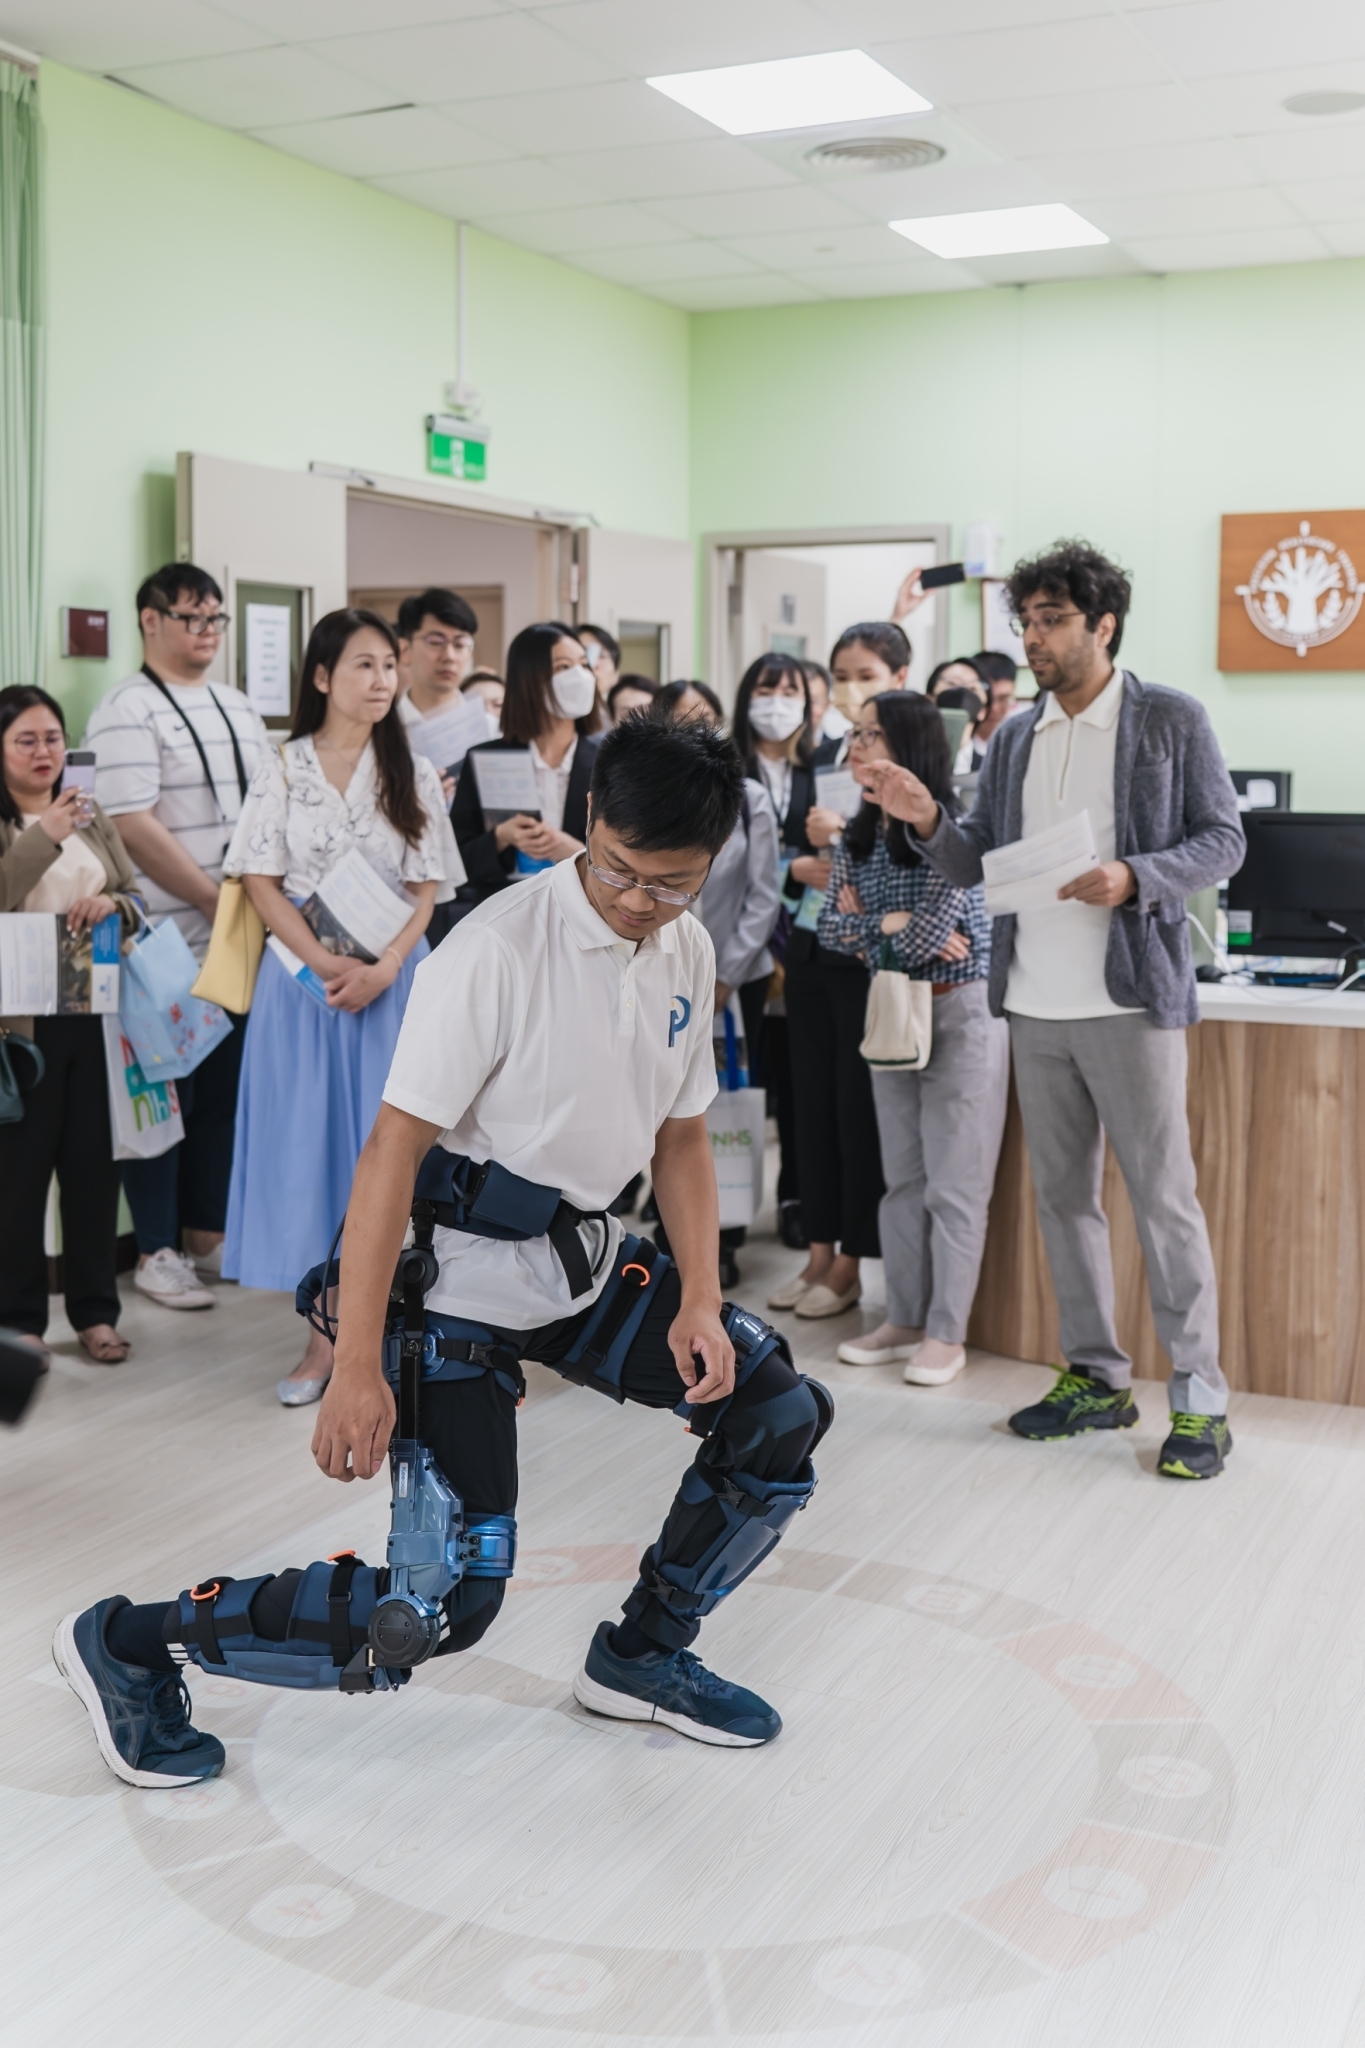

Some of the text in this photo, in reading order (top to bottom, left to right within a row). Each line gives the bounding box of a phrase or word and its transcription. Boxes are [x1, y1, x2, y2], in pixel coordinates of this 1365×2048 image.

[708, 1128, 752, 1147] NHS
[1135, 1763, 1195, 1793] 12
[530, 1970, 588, 1995] 3
[838, 1960, 900, 1989] 2
